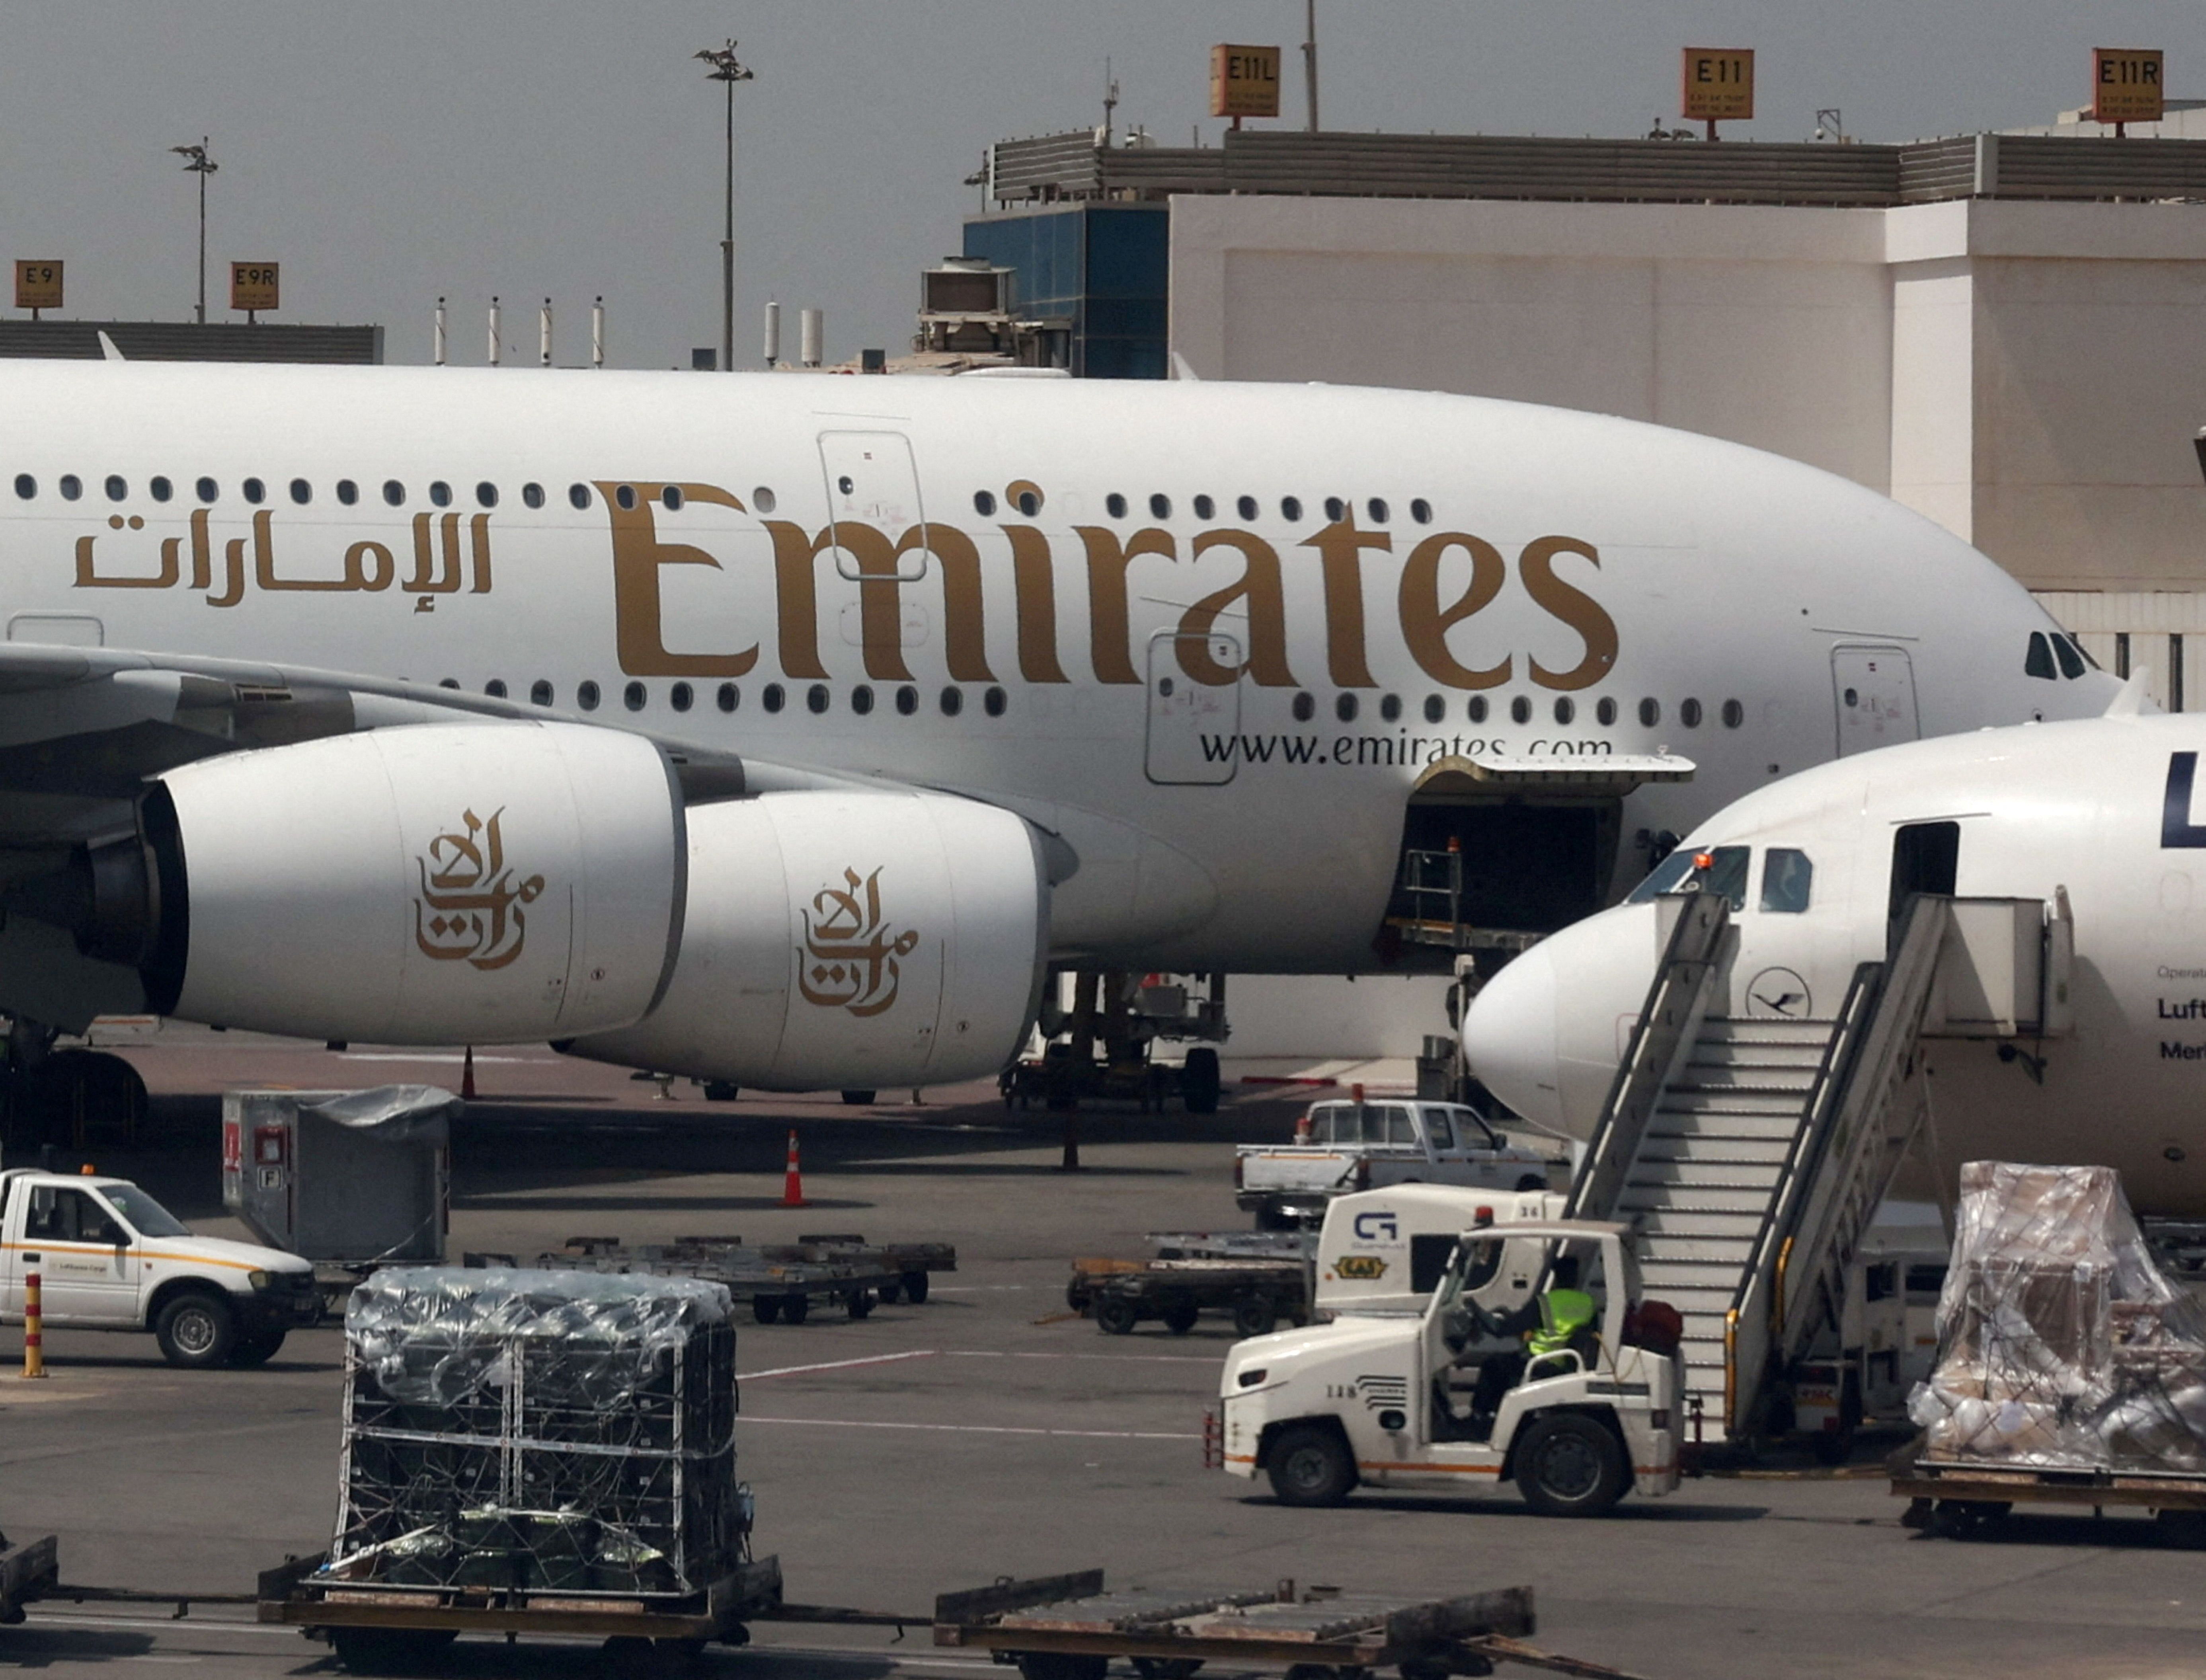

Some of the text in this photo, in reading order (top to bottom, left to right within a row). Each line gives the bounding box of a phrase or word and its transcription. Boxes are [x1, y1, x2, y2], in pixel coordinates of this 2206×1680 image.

[1229, 55, 1275, 80] E11L
[1697, 58, 1741, 84] E11
[2101, 59, 2158, 85] E11R
[26, 267, 53, 284] E9
[236, 269, 273, 285] E9R
[72, 509, 493, 613] الإمارات
[592, 480, 1619, 692] Emirates
[1199, 728, 1613, 765] www.emiratescom
[2158, 965, 2206, 980] Operat
[2161, 1041, 2206, 1060] Mer
[265, 1170, 275, 1186] F
